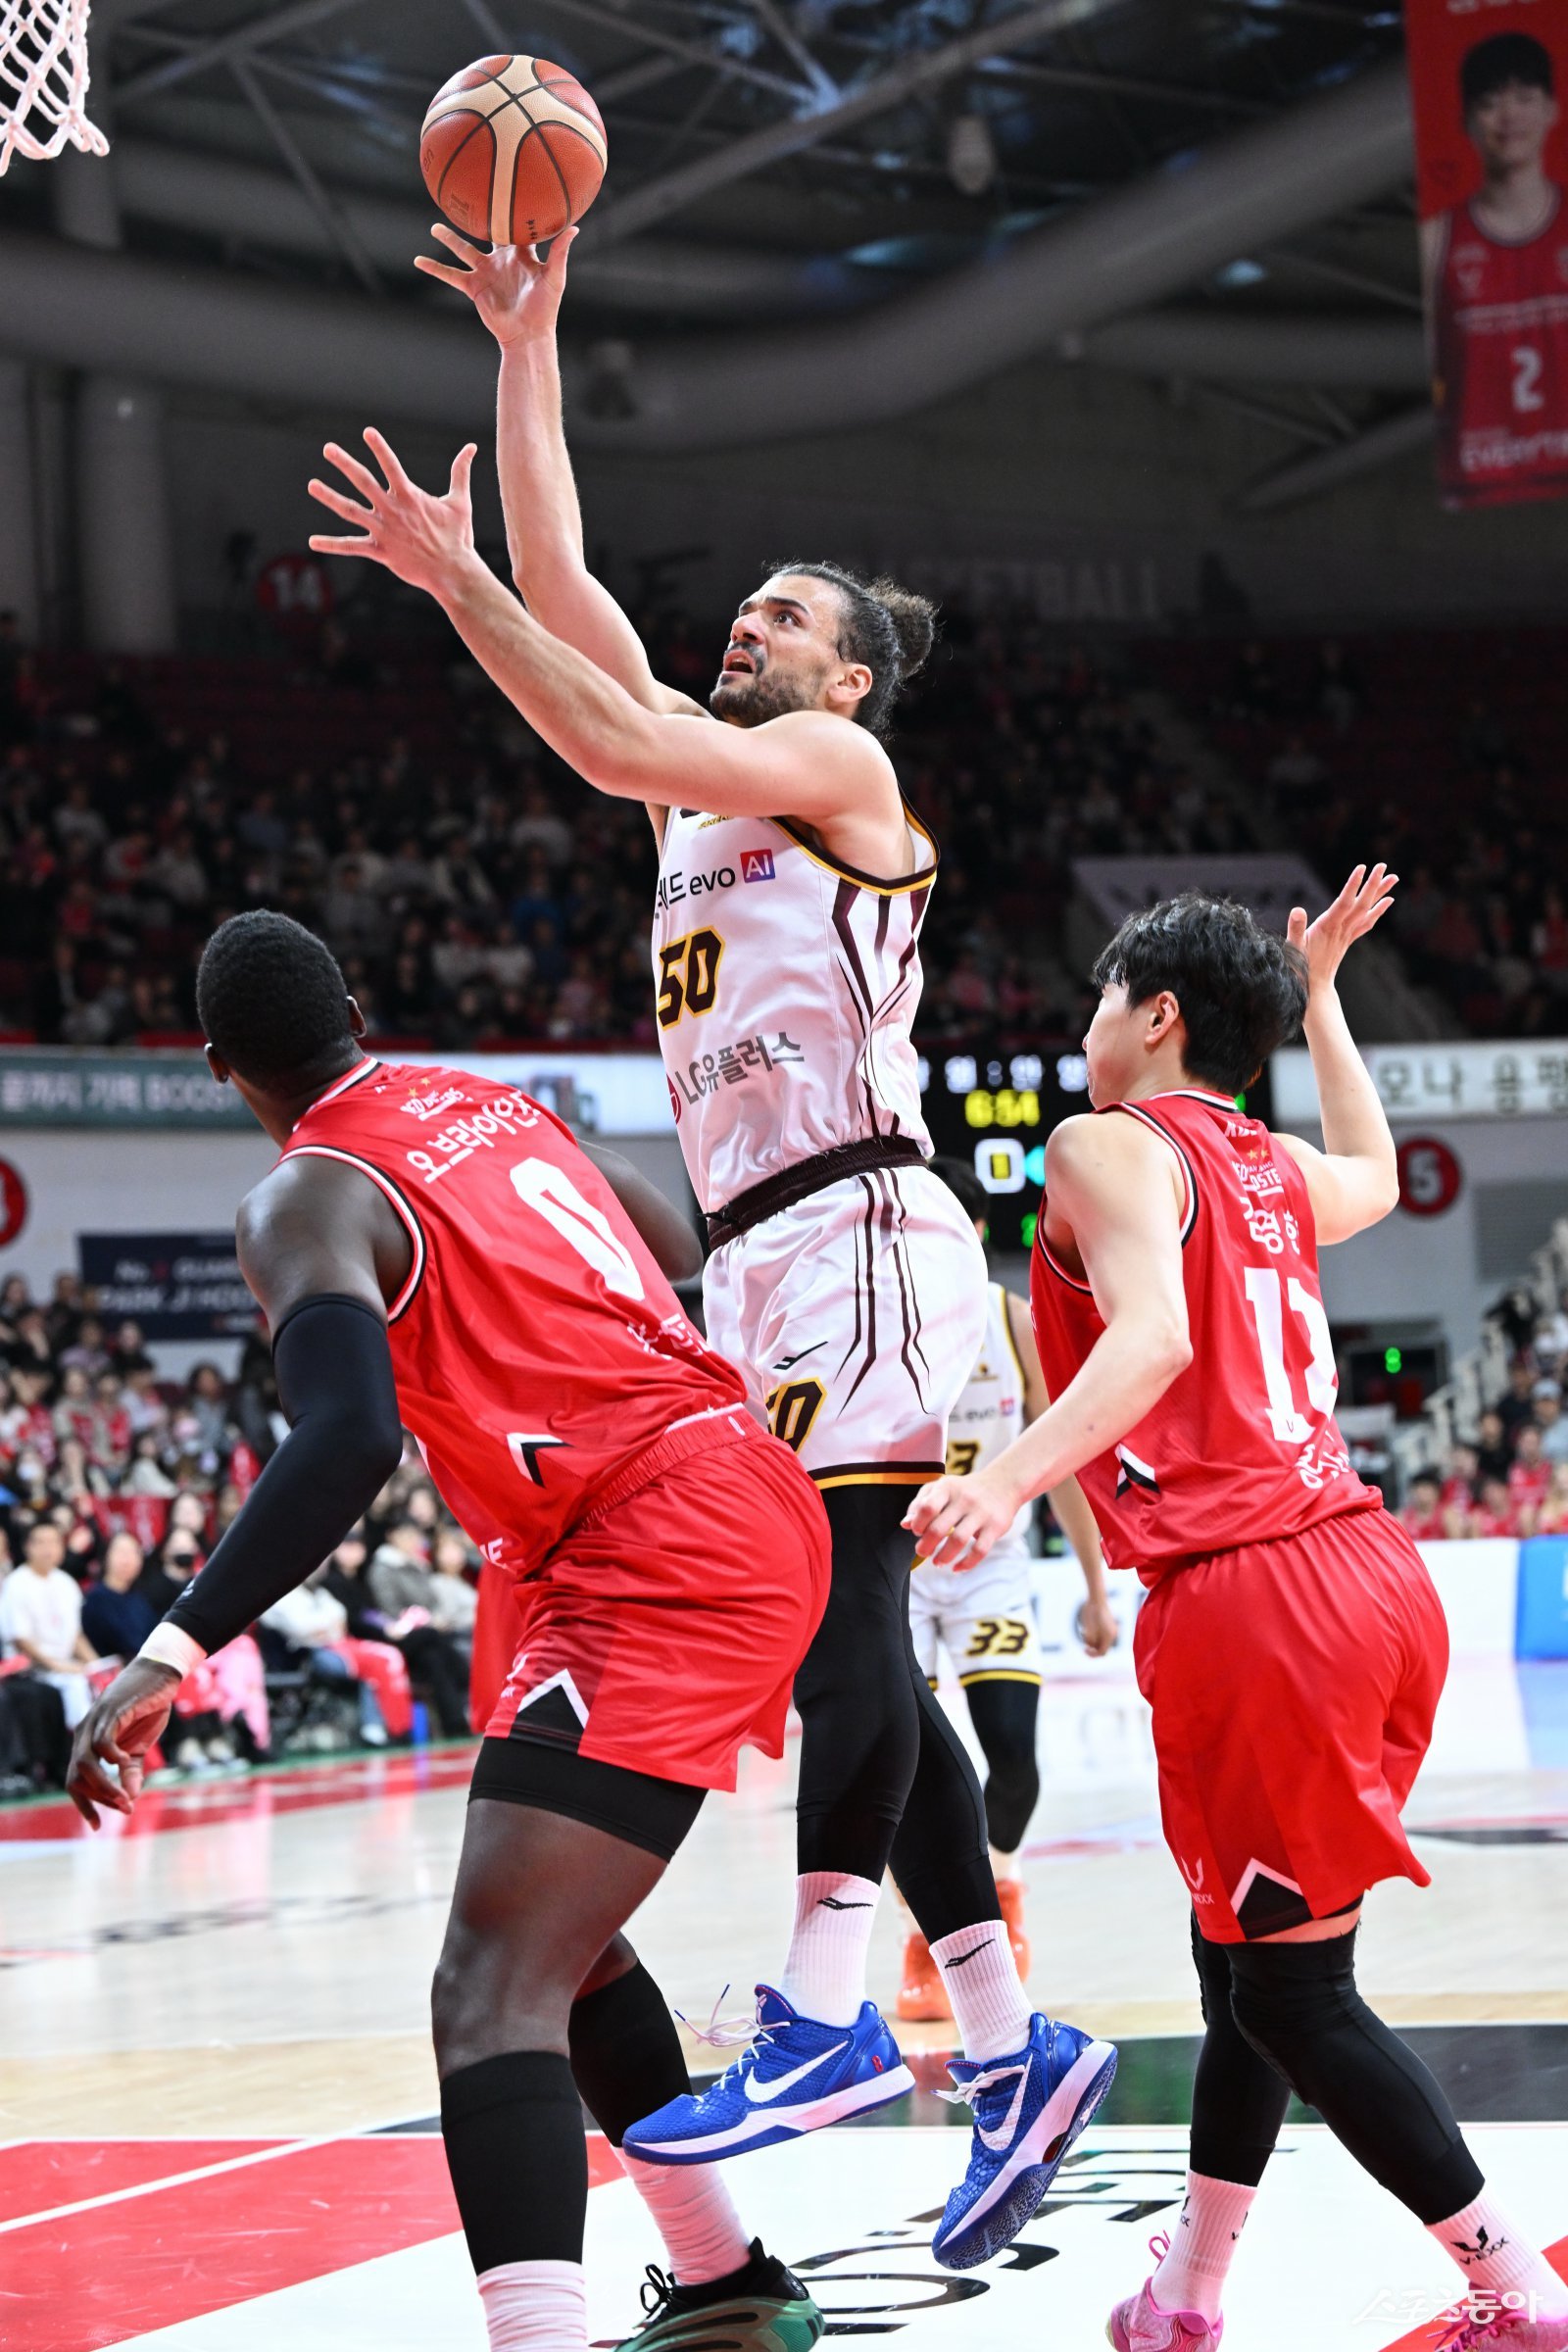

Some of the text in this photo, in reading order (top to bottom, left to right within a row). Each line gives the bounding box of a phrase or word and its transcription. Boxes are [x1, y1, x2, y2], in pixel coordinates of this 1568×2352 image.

[1511, 346, 1544, 412] 2
[746, 854, 771, 879] AI
[659, 926, 725, 1030] 50
[675, 1031, 805, 1105] LG유플러스
[510, 1157, 646, 1301] 0
[1244, 1267, 1338, 1445] 12
[966, 1618, 1030, 1658] 33
